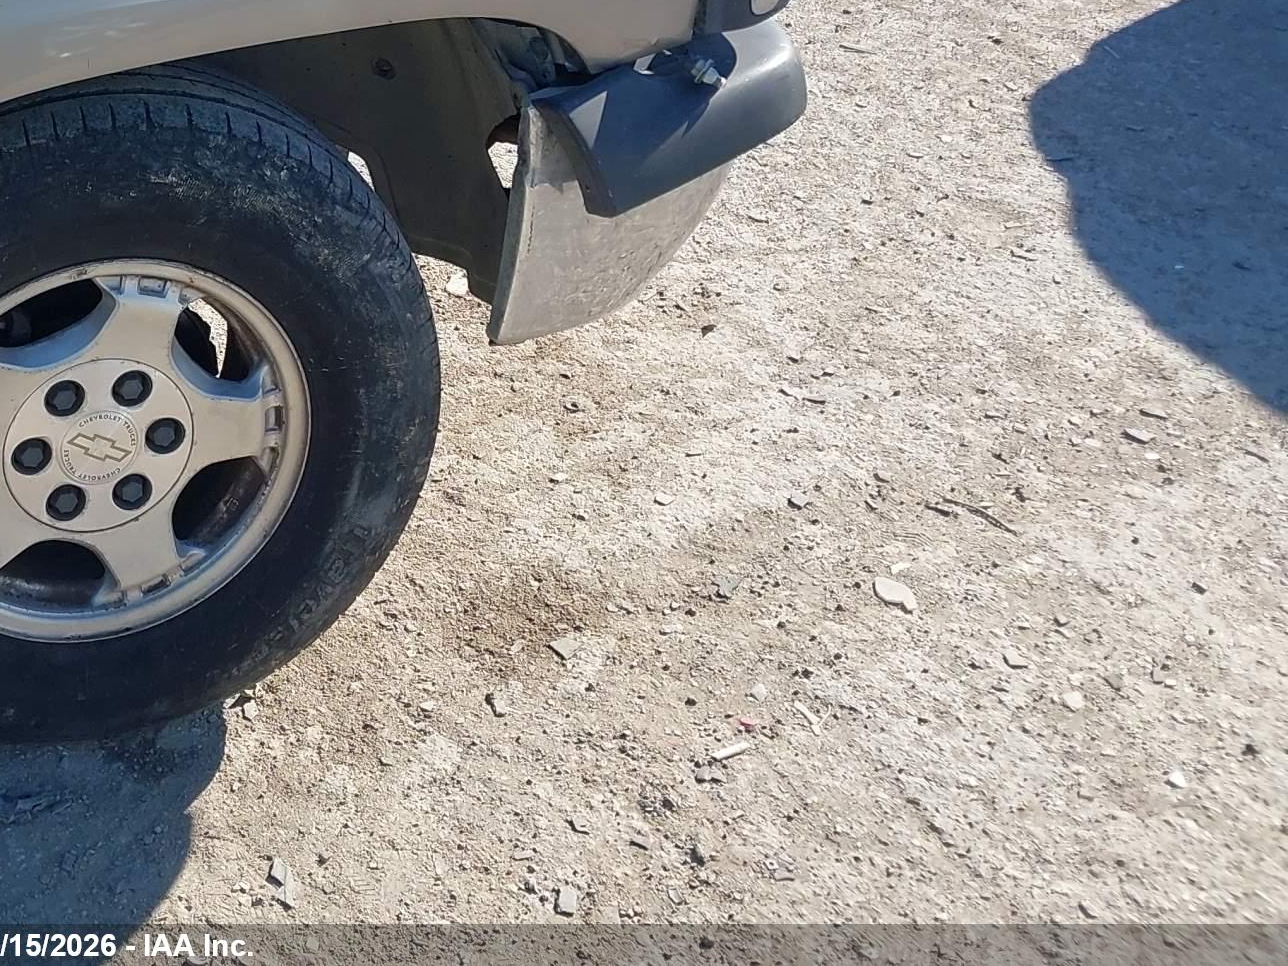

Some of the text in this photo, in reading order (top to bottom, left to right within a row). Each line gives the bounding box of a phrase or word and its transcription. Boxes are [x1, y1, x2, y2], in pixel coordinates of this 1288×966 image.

[78, 414, 137, 447] CHEVROLET TRUCKS
[63, 449, 121, 481] CHEVROLET TRUCKS
